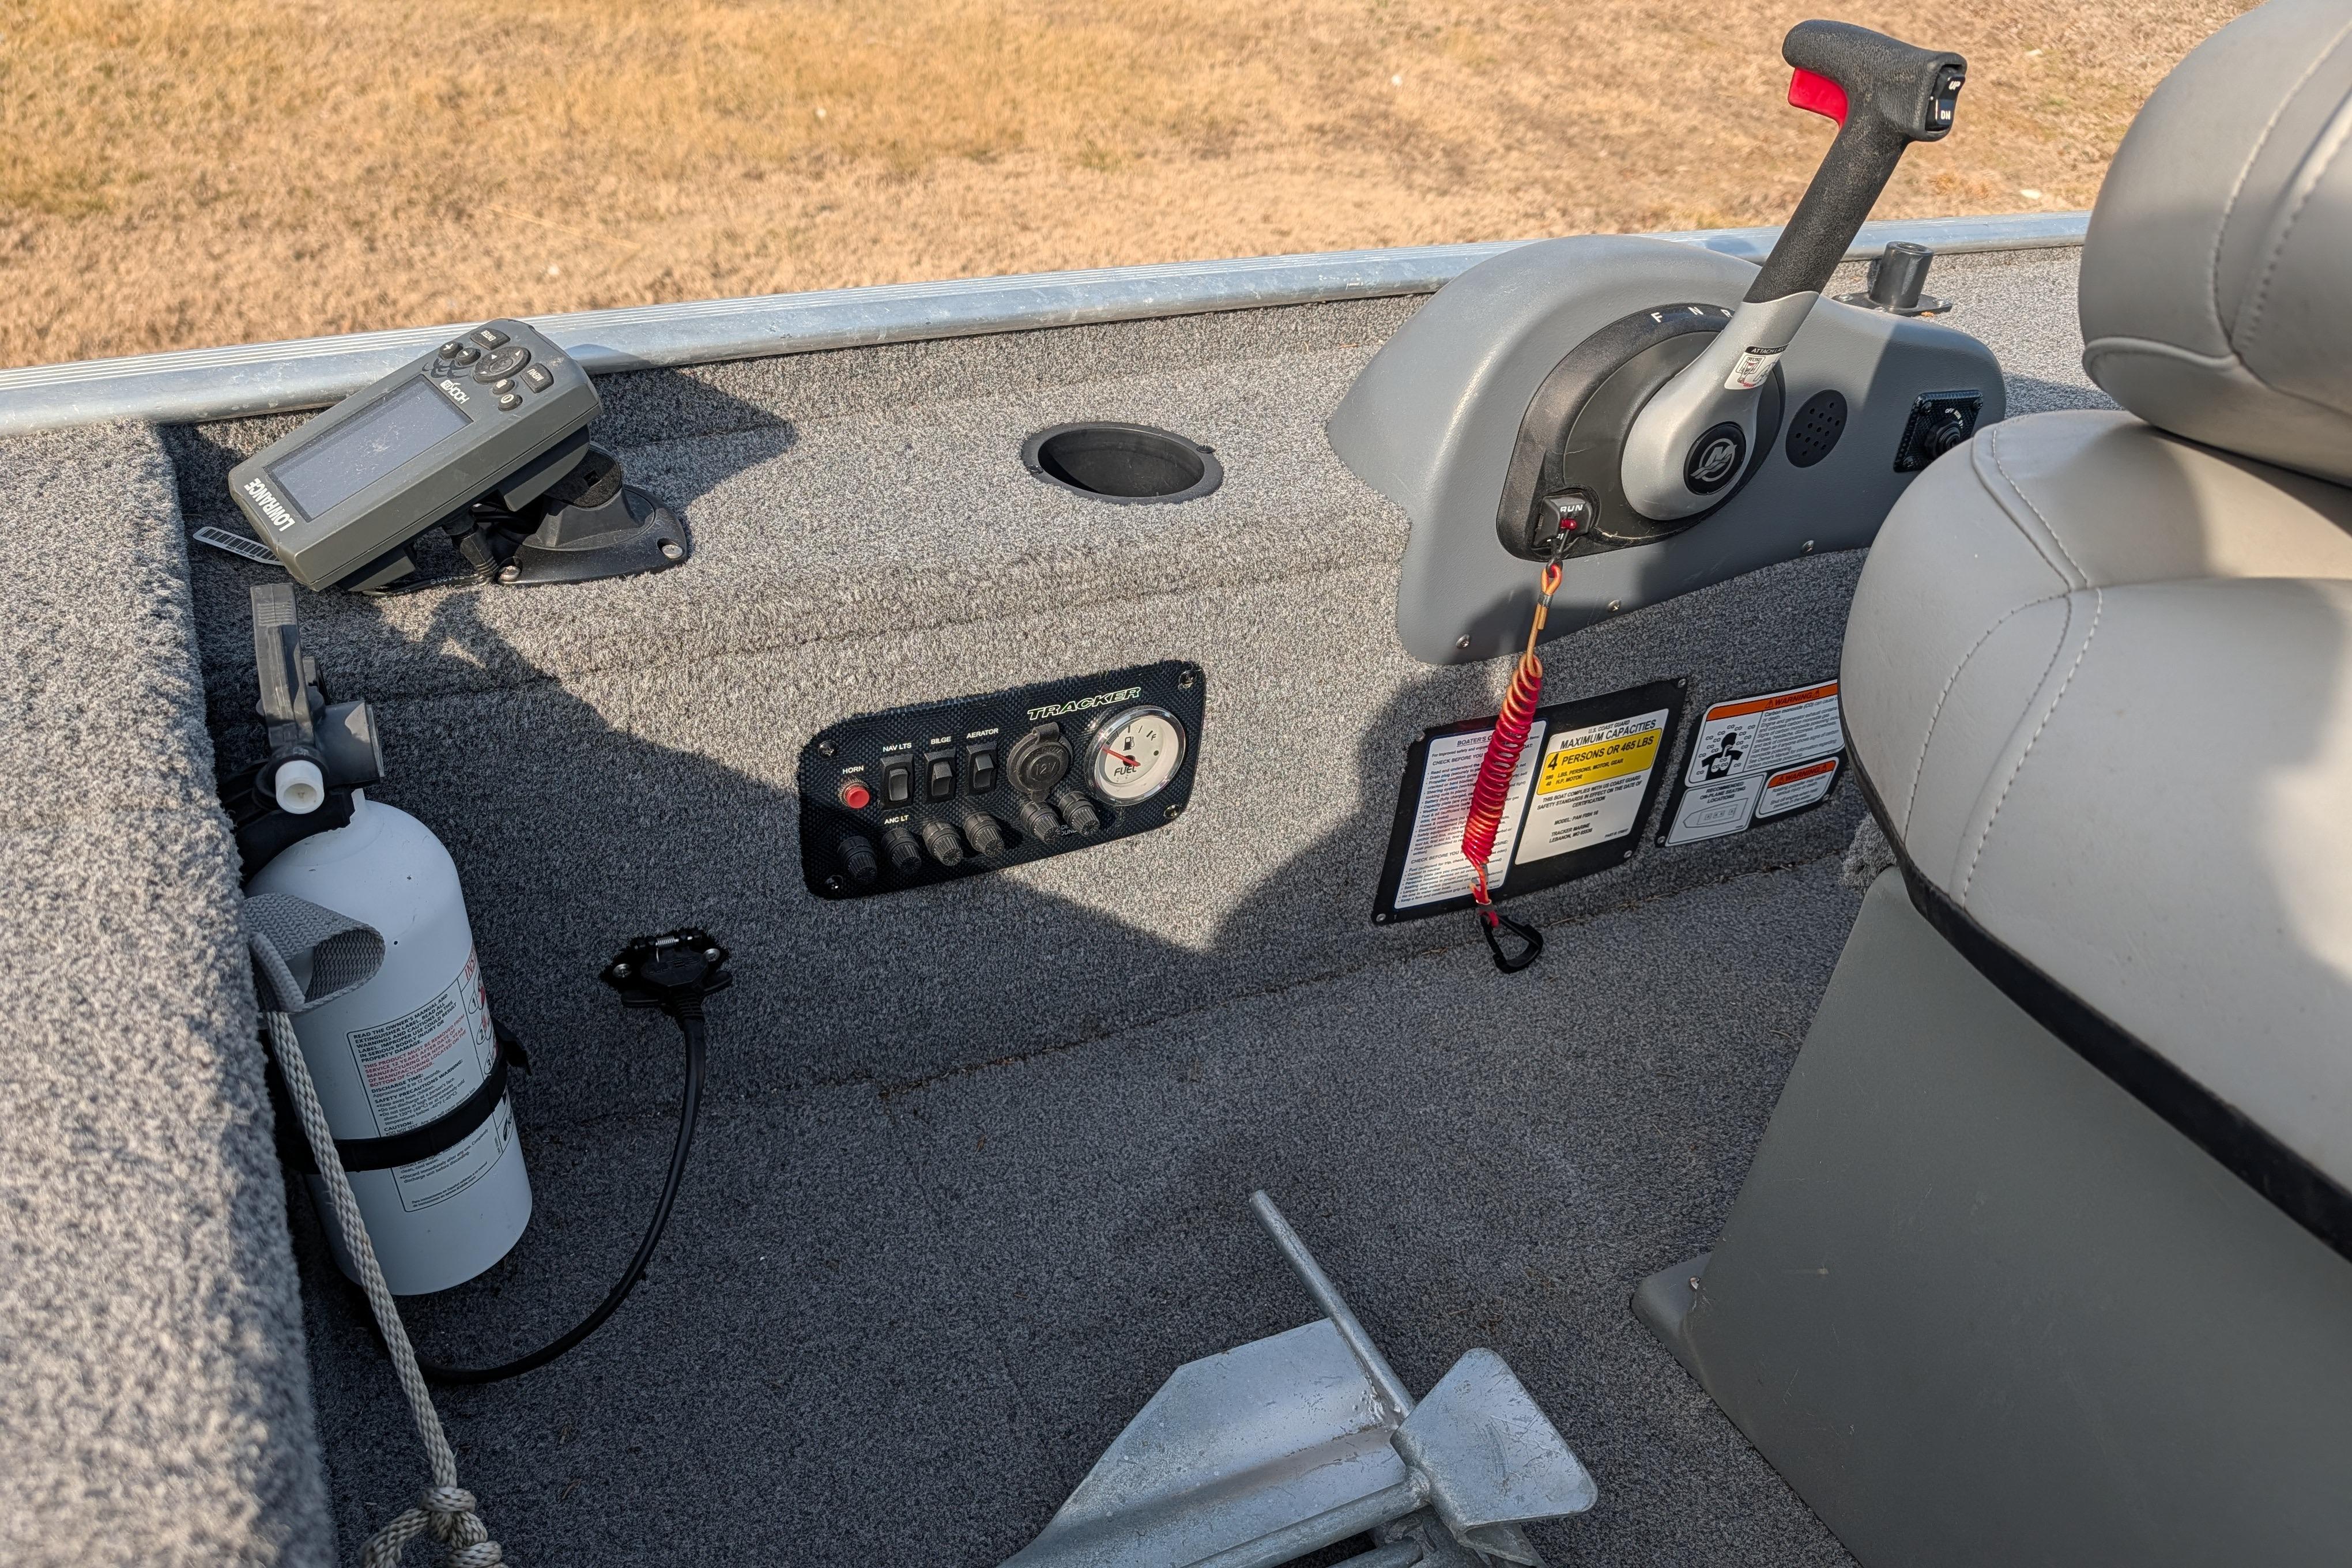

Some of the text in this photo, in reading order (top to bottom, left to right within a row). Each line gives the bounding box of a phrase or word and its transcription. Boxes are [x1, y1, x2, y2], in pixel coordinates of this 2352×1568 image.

[1949, 81, 1961, 91] UP
[1941, 110, 1951, 120] DN
[1651, 312, 1663, 323] F
[1688, 307, 1703, 315] N
[481, 330, 496, 341] ENTER
[527, 368, 544, 381] MENU
[448, 382, 470, 404] HOOK
[1954, 410, 1962, 419] RUN
[244, 478, 295, 532] LOWRANCE
[1560, 504, 1583, 512] RUN
[1027, 687, 1141, 721] TRACKER
[1775, 693, 1812, 706] WARNING
[966, 728, 998, 739] AERATOR
[1560, 719, 1656, 749] MAXIMUM CAPACITIES
[930, 737, 951, 745] BILGE
[1457, 736, 1486, 746] BOATER'S
[1548, 736, 1654, 770] 4 PERSONS OR 465 LBS
[842, 766, 864, 774] HORN
[1036, 762, 1056, 775] 12V
[1114, 765, 1137, 777] FUEL
[1569, 766, 1592, 775] PERSONS,
[1786, 768, 1820, 781] WARNING
[1567, 787, 1590, 798] COMPLIES
[1610, 779, 1624, 787] COAST
[1706, 782, 1744, 793] RECOMMENDED
[1556, 796, 1583, 806] STANDARDS
[1589, 790, 1605, 798] EFFECT
[1572, 796, 1606, 808] CERTIFICATION
[1699, 791, 1725, 800] ON-PLANE
[1707, 794, 1735, 804] LOCATIONS
[884, 816, 899, 824] ANC
[1549, 834, 1571, 843] LEBANON,
[1551, 828, 1573, 836] TRACKER
[472, 997, 476, 1008] 1
[386, 1017, 414, 1031] OWNER'S
[414, 1004, 437, 1019] MANUAL
[439, 994, 448, 1004] AND
[355, 1027, 401, 1044] EXTINGUISHER
[422, 1009, 435, 1020] READ
[436, 1002, 445, 1011] ALL
[356, 1000, 453, 1049] WARNINGS AND CAUTIONS ON THIS
[381, 1034, 412, 1047] IMPROPER
[425, 1016, 442, 1029] COULD
[442, 1002, 457, 1018] RESULT
[368, 1045, 394, 1056] SERIOUS
[396, 1036, 417, 1048] BODILY
[418, 1026, 436, 1039] INJURY
[437, 1019, 444, 1027] OR
[379, 1053, 406, 1065] PRODUCT
[408, 1046, 423, 1056] MUST
[432, 1025, 453, 1043] REMOVED
[454, 1014, 465, 1026] FROM
[479, 1028, 484, 1038] 2
[361, 1040, 423, 1062] PROPERTY DAMAGE.
[365, 1064, 390, 1073] SERVICE
[401, 1053, 419, 1063] YEARS
[420, 1045, 436, 1056] AFTER
[437, 1036, 450, 1046] DATE
[367, 1059, 420, 1078] MANUFACTURING
[421, 1051, 431, 1060] PER
[379, 1058, 430, 1080] MANUFACTURING
[431, 1043, 452, 1060] LOCATED
[370, 1079, 396, 1088] BOTTOM
[406, 1062, 435, 1077] CYLINDER.
[375, 1060, 463, 1103] SAFETY PRECAUTIONS WARNING:
[371, 1074, 424, 1093] DISCHARGE TIME:
[384, 1121, 414, 1132] CAUTION:
